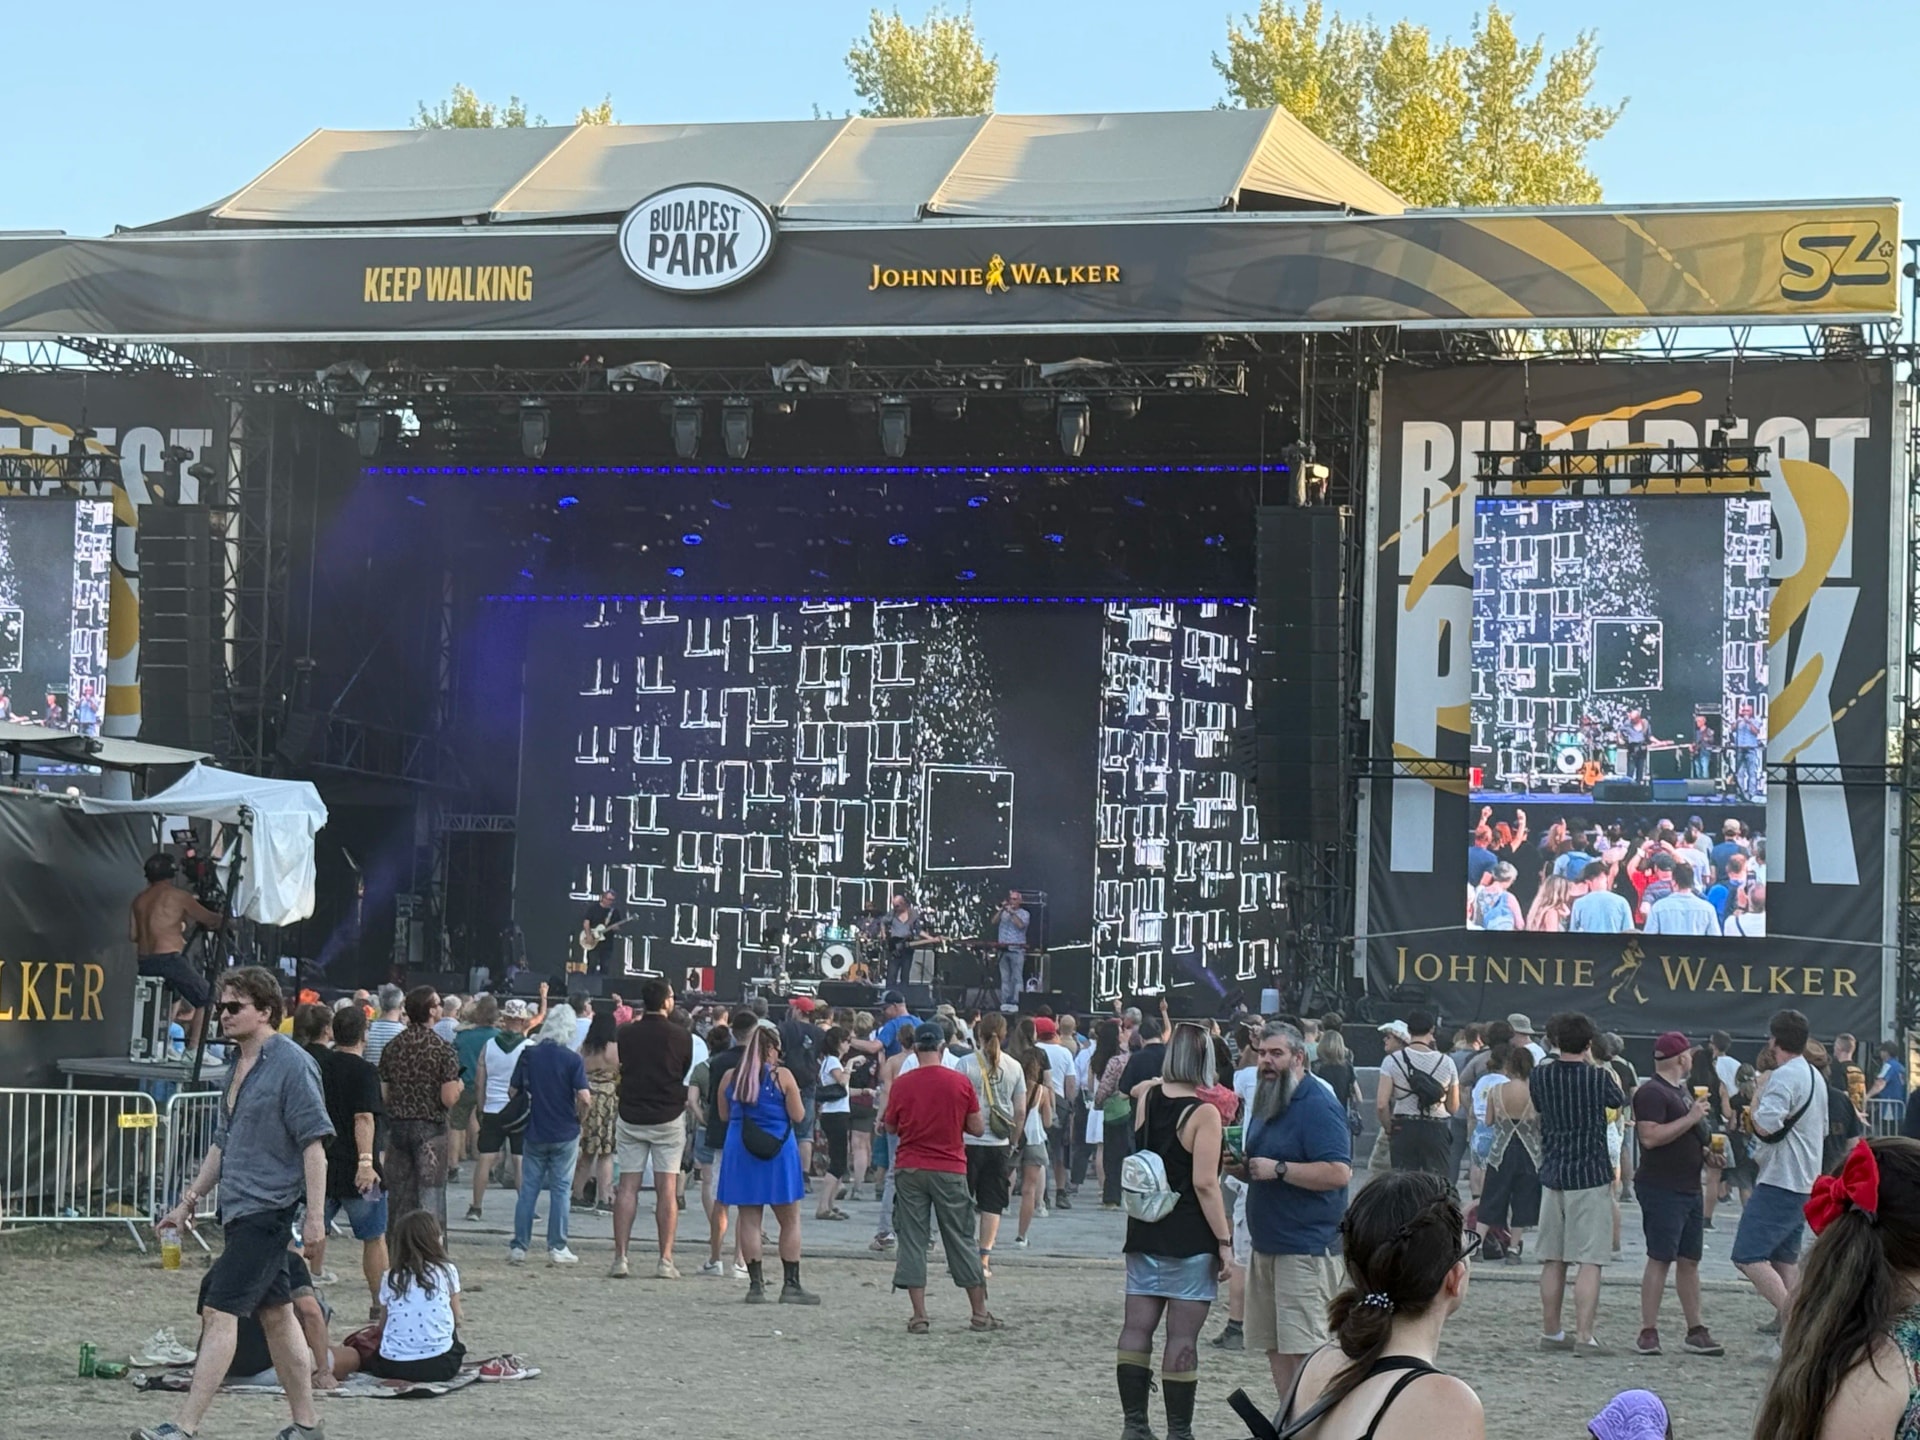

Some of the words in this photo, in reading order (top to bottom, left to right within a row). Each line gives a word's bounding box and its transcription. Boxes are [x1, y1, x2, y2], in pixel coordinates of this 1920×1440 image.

[650, 200, 741, 232] BUDAPEST
[648, 232, 740, 277] PARK
[364, 267, 422, 302] KEEP
[426, 265, 533, 301] WALKING
[868, 264, 983, 290] JOHNNIE
[1010, 263, 1121, 286] WALKER
[1389, 584, 1862, 886] PK
[1396, 946, 1596, 987] JOHNNIE
[1660, 955, 1859, 998] WALKER
